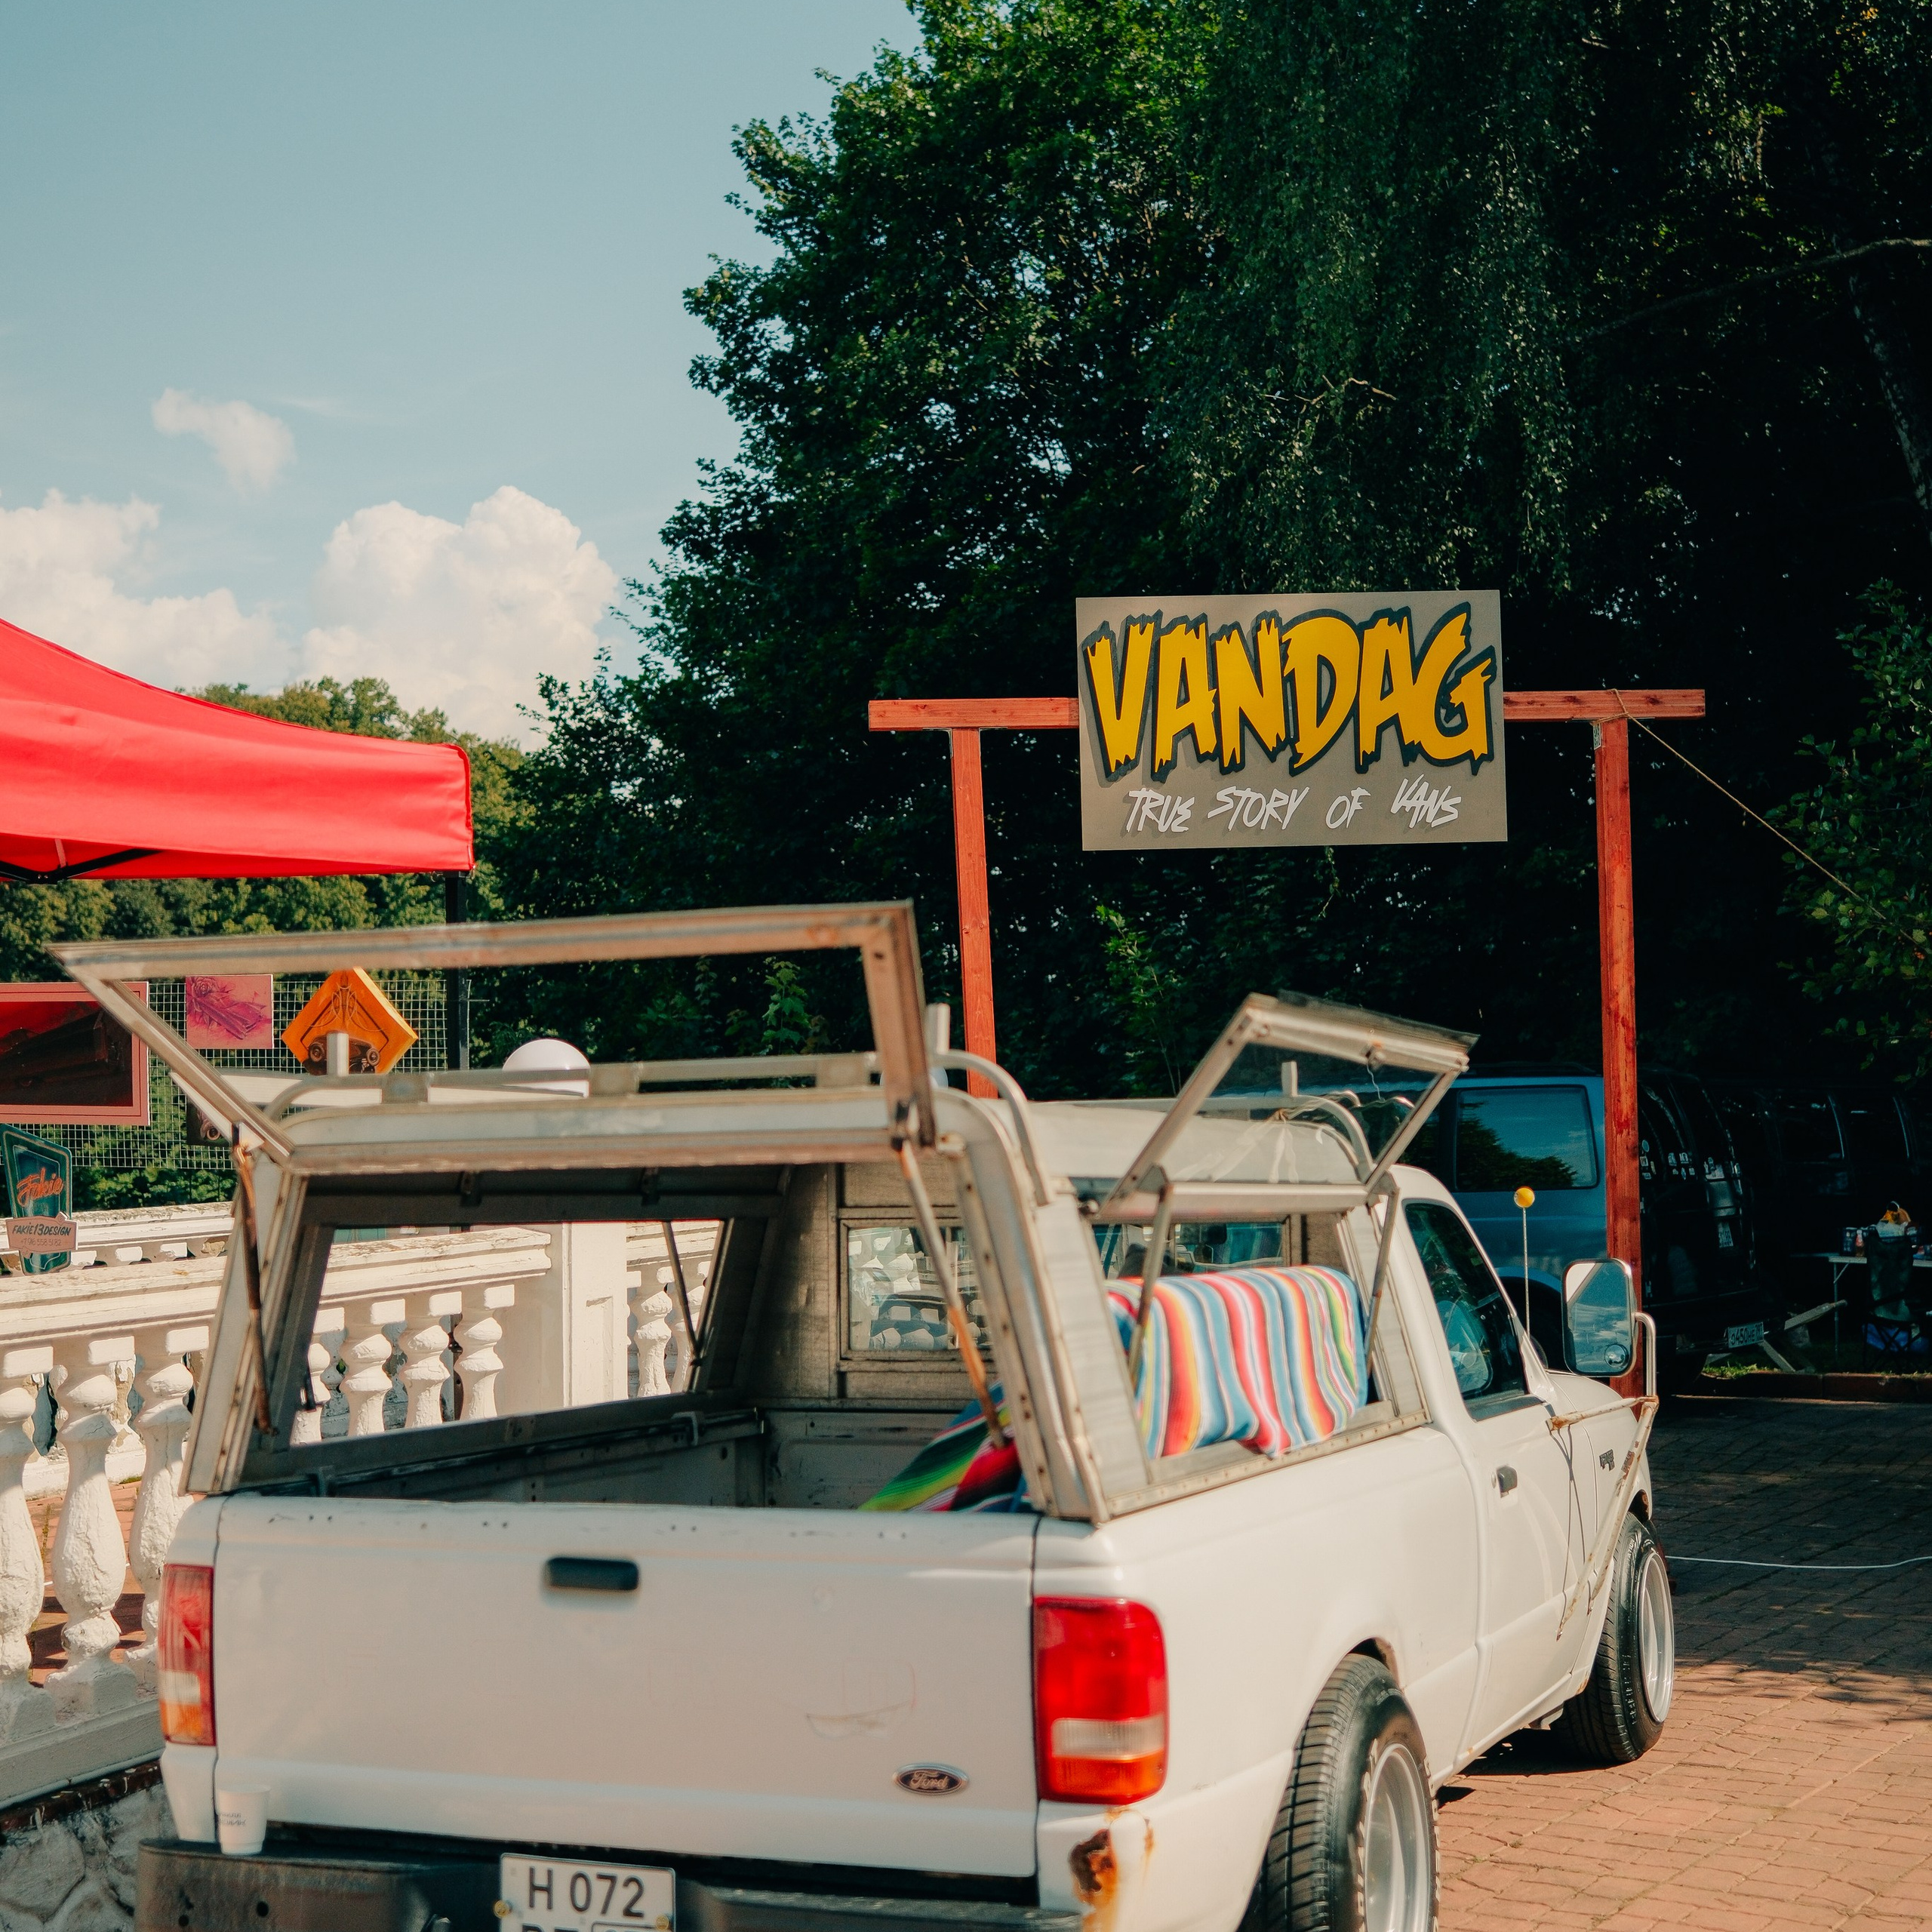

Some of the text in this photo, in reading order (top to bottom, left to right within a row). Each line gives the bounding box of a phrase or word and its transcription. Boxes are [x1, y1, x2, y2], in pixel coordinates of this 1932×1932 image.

[1081, 601, 1497, 784] VANDAG
[1126, 774, 1462, 832] TRUE STORY OF VANS
[909, 1770, 949, 1789] Ford
